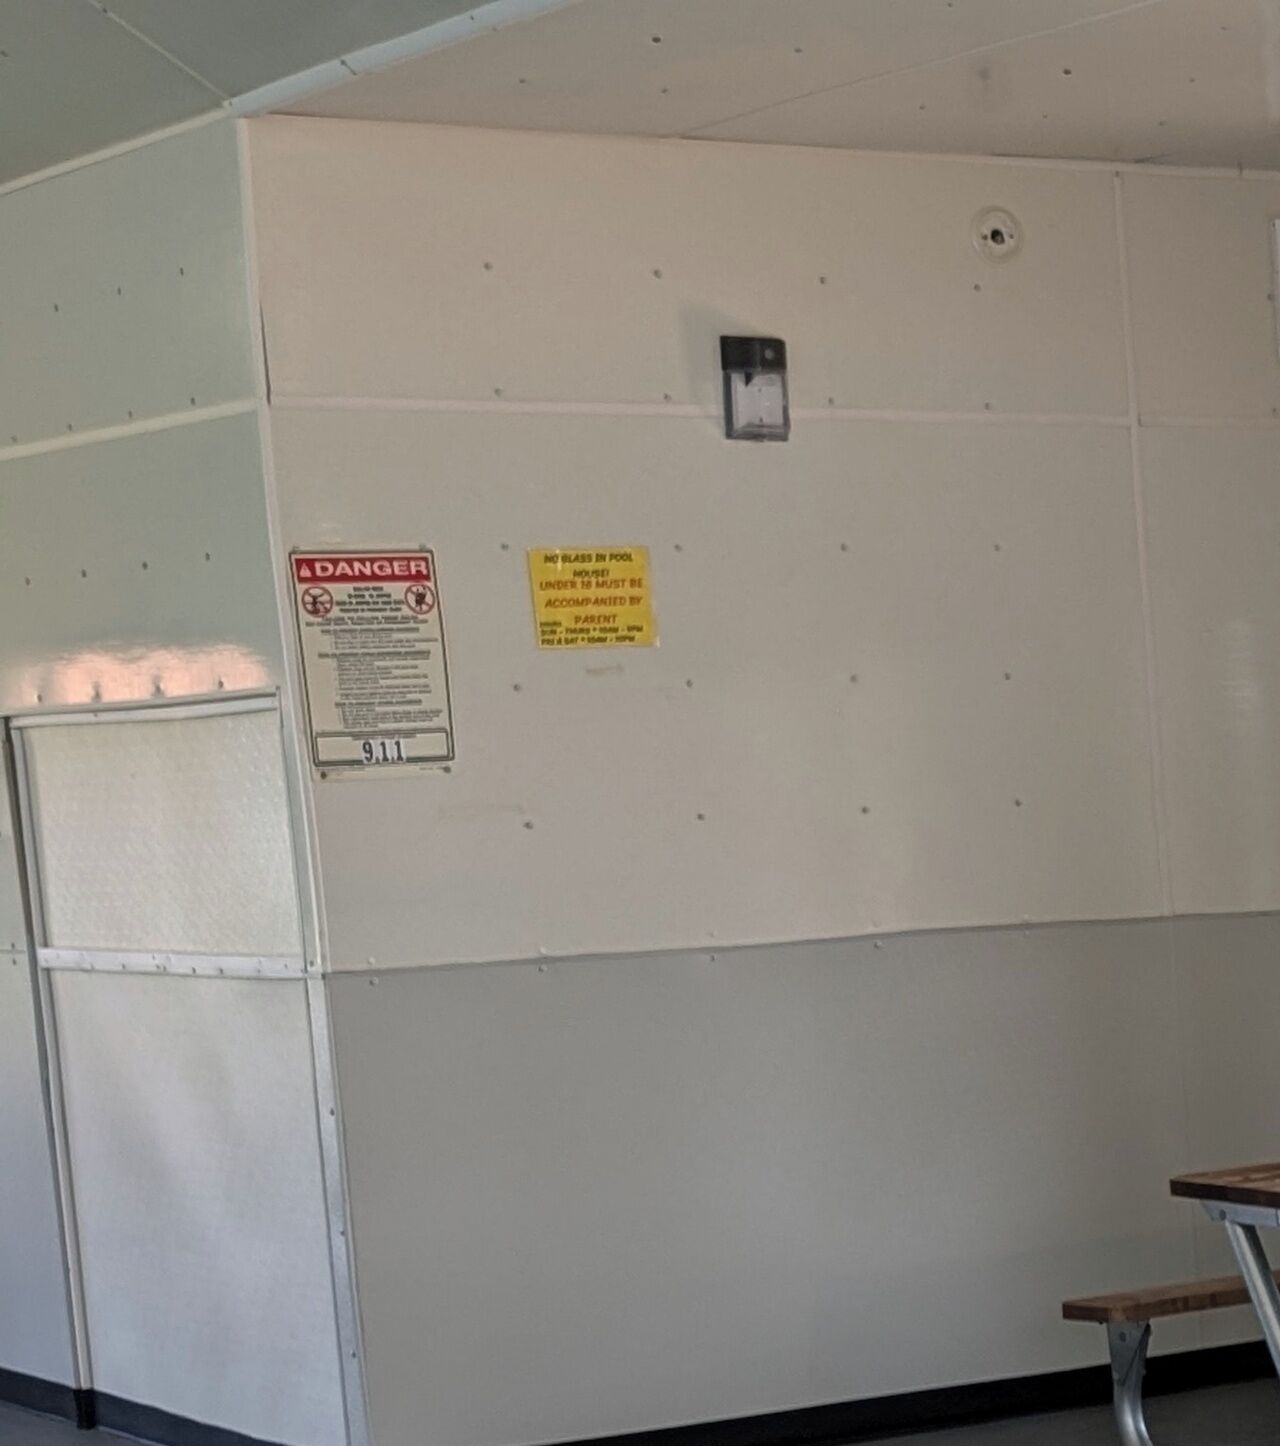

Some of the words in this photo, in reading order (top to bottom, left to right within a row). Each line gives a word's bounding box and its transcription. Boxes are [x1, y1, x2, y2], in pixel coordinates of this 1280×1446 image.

[544, 554, 558, 564] NO
[561, 553, 592, 563] GLASS
[595, 553, 606, 563] IN
[609, 552, 633, 562] POOL
[314, 561, 428, 577] DANGER
[539, 580, 577, 591] UNDER
[595, 579, 626, 589] MUST
[630, 578, 643, 588] BE
[544, 596, 627, 609] ACCOMPANIED
[629, 596, 643, 606] BY
[574, 614, 618, 625] PARENT
